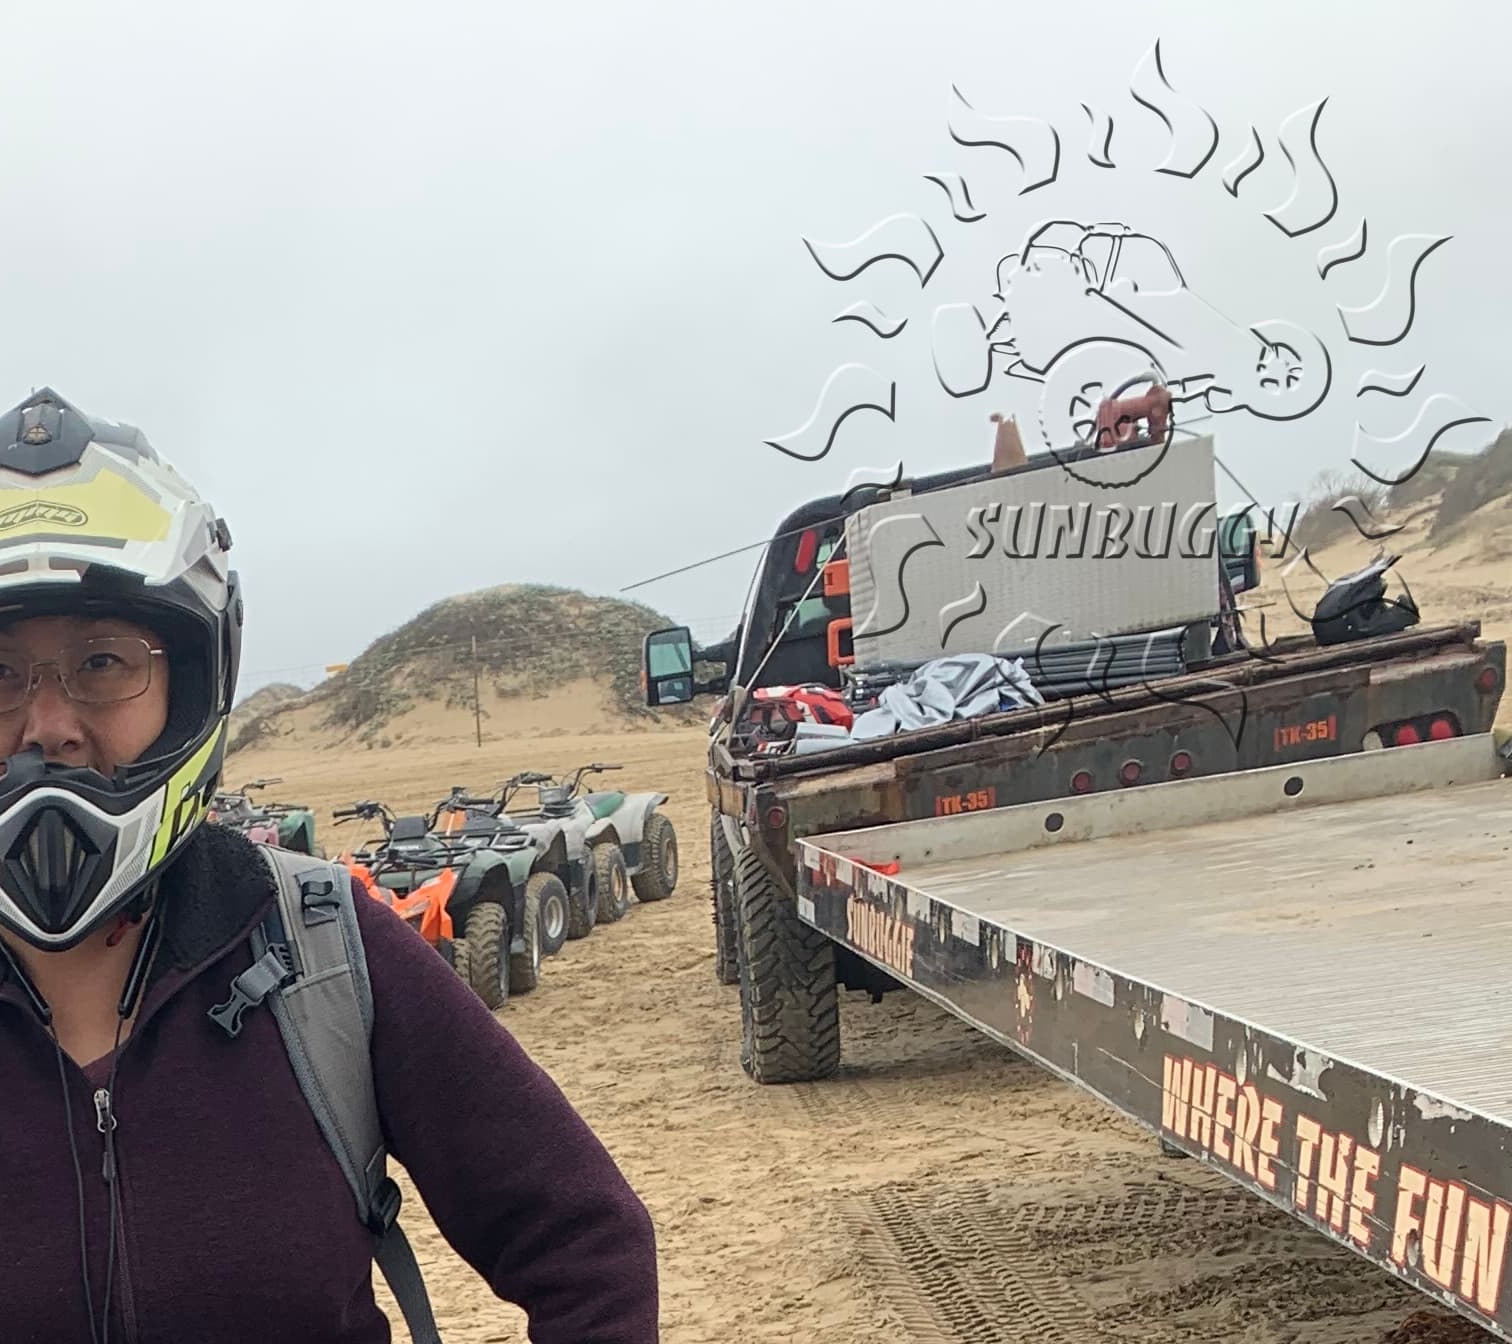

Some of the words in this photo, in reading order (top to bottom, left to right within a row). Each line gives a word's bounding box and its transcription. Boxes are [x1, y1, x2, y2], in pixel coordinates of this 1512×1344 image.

[1161, 1053, 1284, 1192] WHERE
[1295, 1112, 1382, 1249] THE
[1390, 1162, 1512, 1317] FUN
